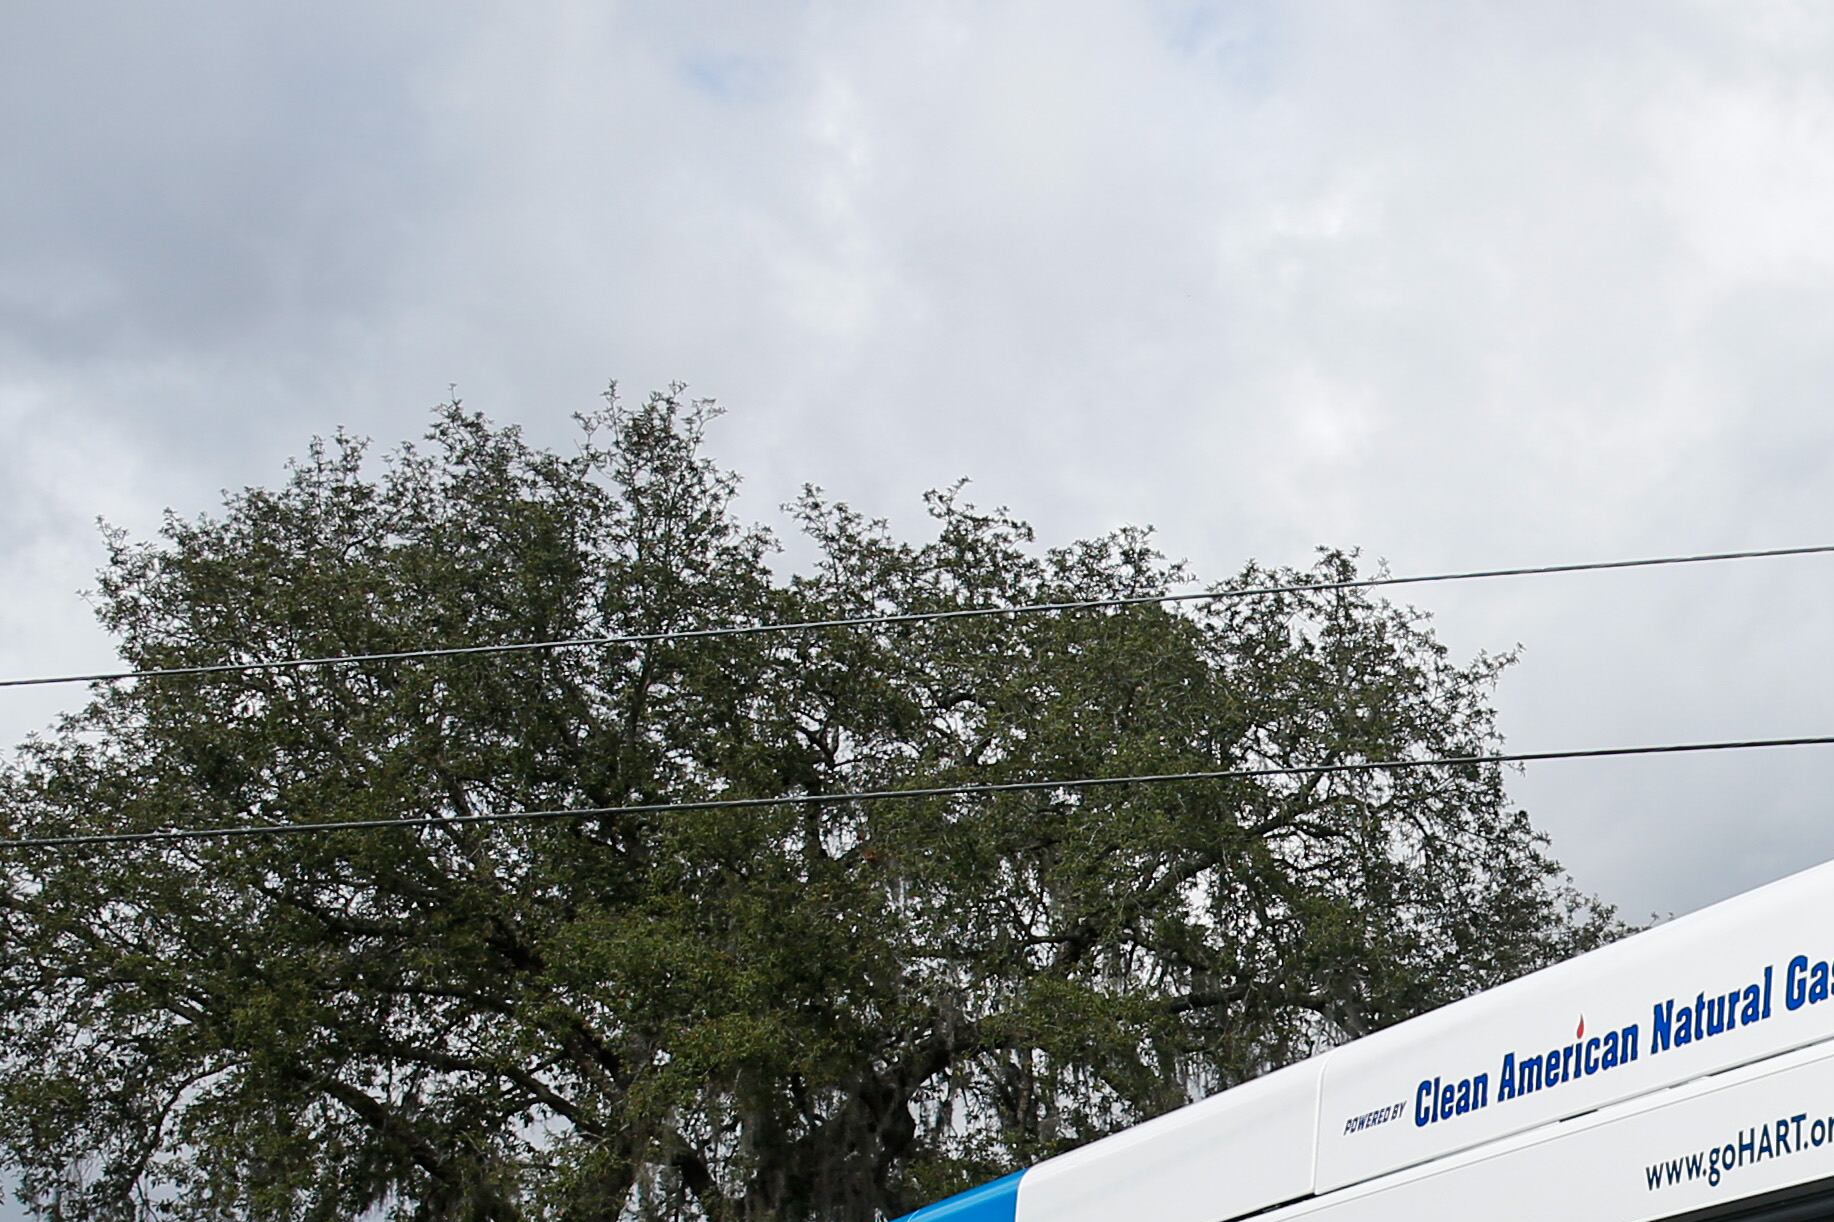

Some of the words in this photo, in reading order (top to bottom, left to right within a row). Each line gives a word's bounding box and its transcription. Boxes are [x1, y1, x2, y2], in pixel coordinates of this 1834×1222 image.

[1343, 1104, 1391, 1135] POWERED
[1391, 1100, 1407, 1118] BY
[1414, 1072, 1488, 1128] Clean
[1497, 1023, 1639, 1103] American
[1650, 965, 1773, 1055] Natural
